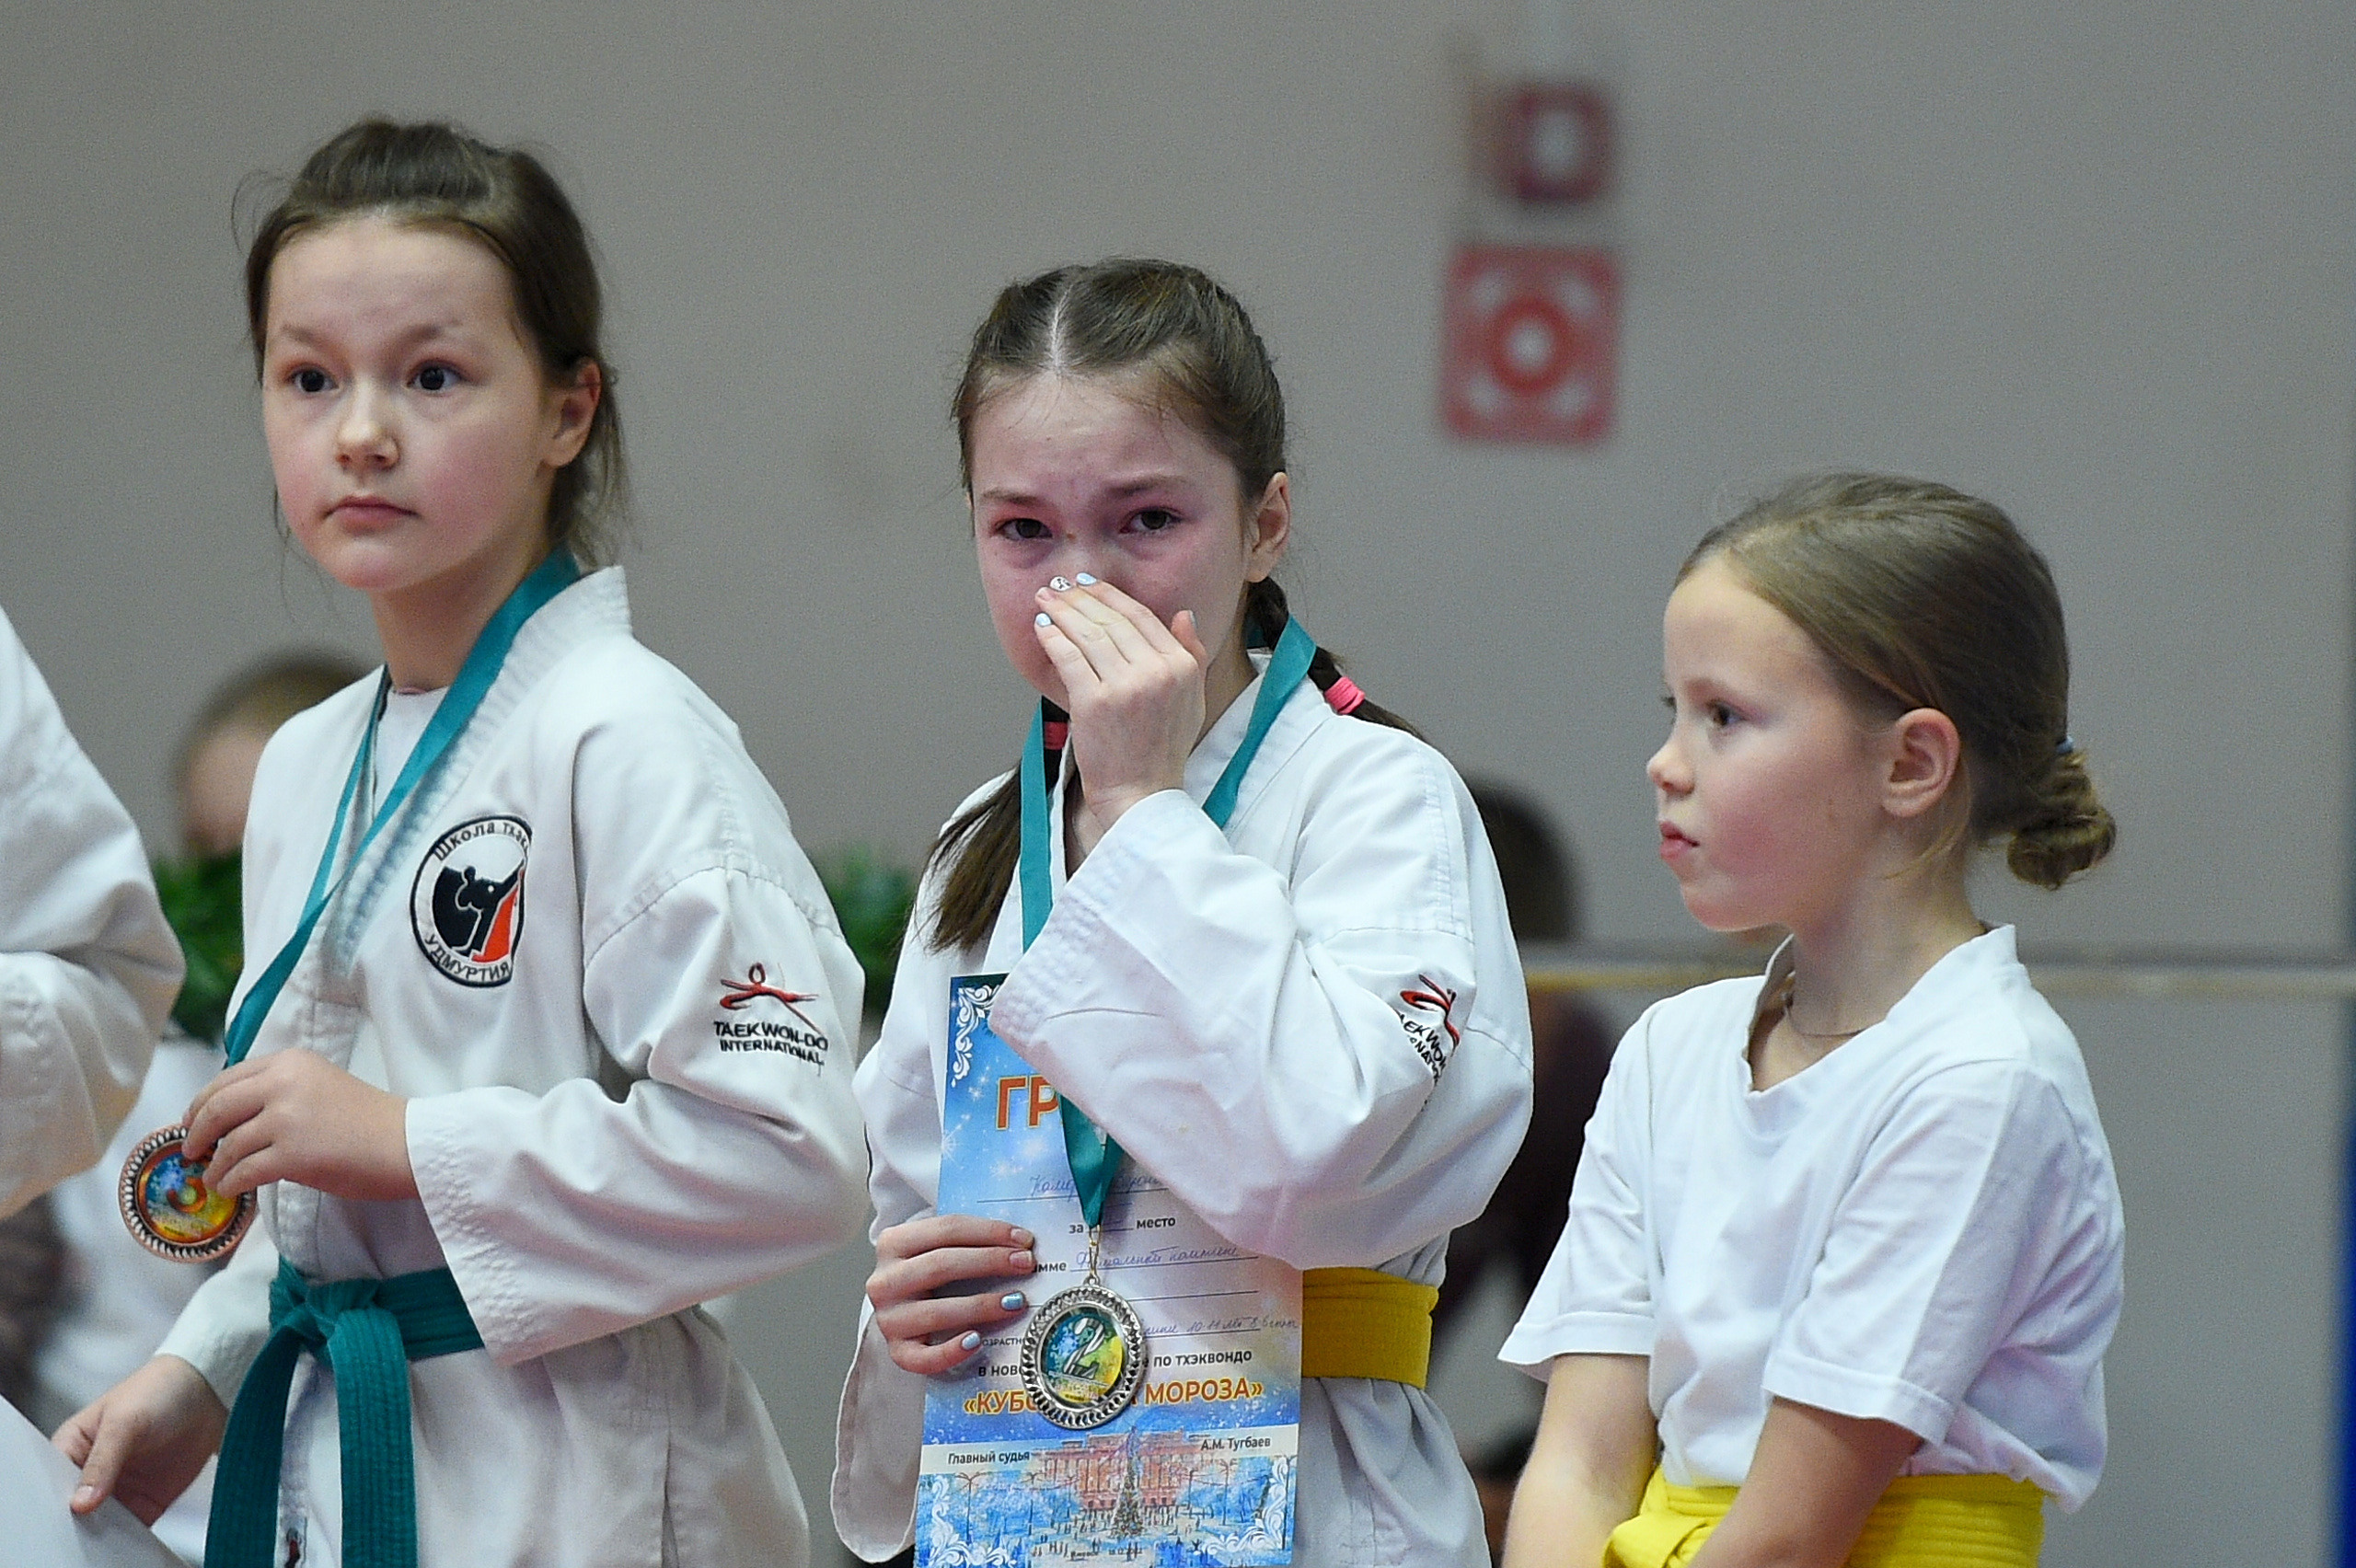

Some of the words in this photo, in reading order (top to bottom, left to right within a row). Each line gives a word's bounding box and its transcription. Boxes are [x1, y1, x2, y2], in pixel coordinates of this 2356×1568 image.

[433, 822, 495, 862] Школа
[425, 933, 510, 981] УДМУРТИЯ
[720, 1039, 825, 1066] INTERNATIONAL
[1068, 1224, 1083, 1234] за
[1136, 1217, 1176, 1228] место
[1063, 1317, 1104, 1379] 2
[1144, 1378, 1265, 1405] МОРОЗА»
[1200, 1438, 1224, 1451] А.М.
[1227, 1435, 1271, 1452] Тугбаев
[948, 1450, 996, 1465] Главный
[999, 1451, 1030, 1465] судья
